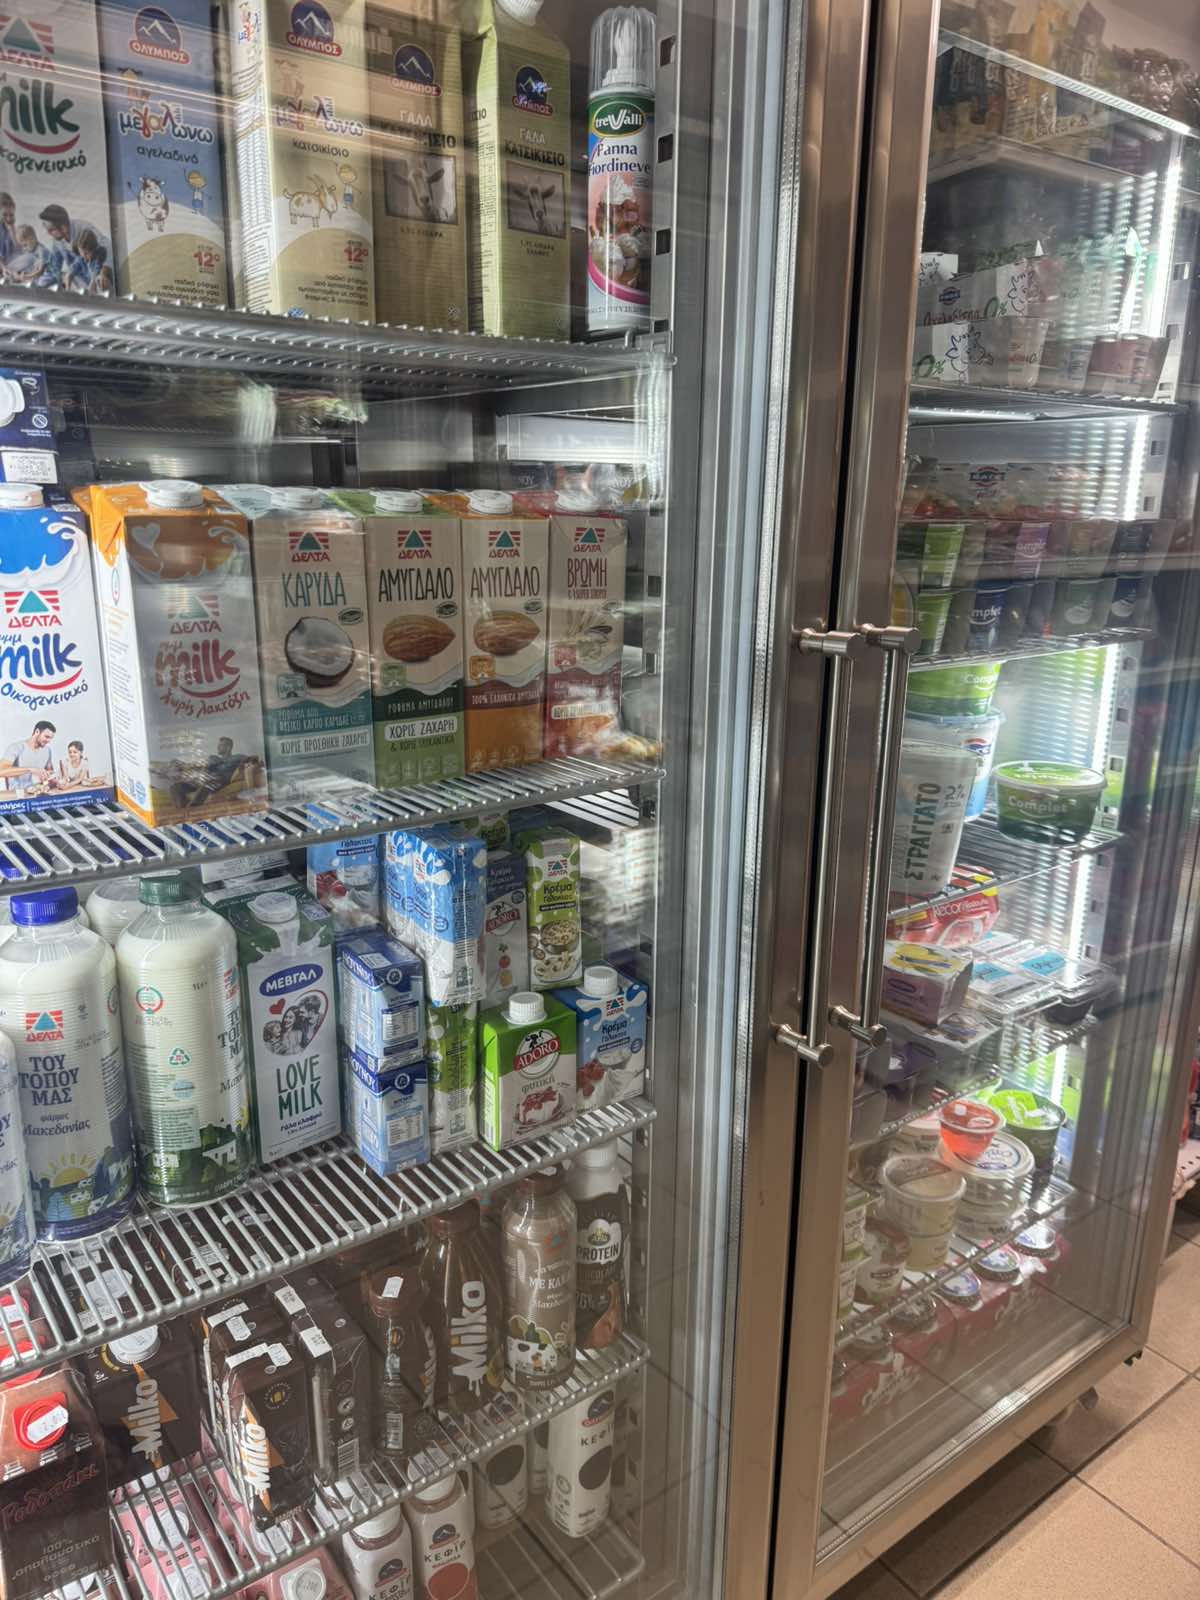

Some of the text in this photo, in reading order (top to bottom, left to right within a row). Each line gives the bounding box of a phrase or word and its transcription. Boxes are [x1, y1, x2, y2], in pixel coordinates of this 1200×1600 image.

[130, 41, 190, 62] ΟΛΥΜΠΟΣ
[287, 33, 341, 55] ΟΛΥΜΠΟΣ
[390, 78, 439, 95] ΟΛΥΜΠΟΣ
[291, 551, 331, 562] ΔΕΛΤΑ
[398, 550, 432, 559] ΔΕΛΤΑ
[489, 550, 521, 558] ΔΕΛΤΑ
[573, 544, 602, 553] ΔΕΛΤΑ
[470, 566, 541, 599] ΑΜΥΓΔΑΛΟ
[567, 557, 608, 588] ΒΡΩΜΗ
[281, 571, 347, 608] ΚΑΡΥΔΑ
[378, 567, 455, 602] ΑΜΥΓΔΑΛΟ
[8, 615, 62, 628] ΔΕΛΤΑ
[170, 620, 222, 635] ΔΕΛΤΑ
[0, 633, 82, 680] milk
[155, 639, 241, 688] milk
[0, 680, 89, 711] Οικογενειακό
[390, 719, 455, 740] ΧΩΡΙΣ ΖΑΧΑΡΗ
[1008, 795, 1069, 816] Complet
[903, 782, 942, 881] ΣΤΡΑΓΓΑΤΟ
[543, 882, 573, 896] Κρέμα
[265, 969, 318, 993] ΜΕΒΓΑΛ
[26, 1030, 65, 1042] ΔΕΛΤΑ
[601, 1020, 628, 1036] Κρέμα
[29, 1054, 66, 1072] ΤΟΥ
[517, 1038, 560, 1068] ADORO
[18, 1067, 80, 1089] ΤΟΠΟΥ
[276, 1054, 322, 1094] LOVE
[31, 1087, 73, 1106] ΜΑΣ
[278, 1080, 323, 1120] MILK
[577, 1244, 620, 1261] PROTEIN
[450, 1279, 488, 1396] Milko
